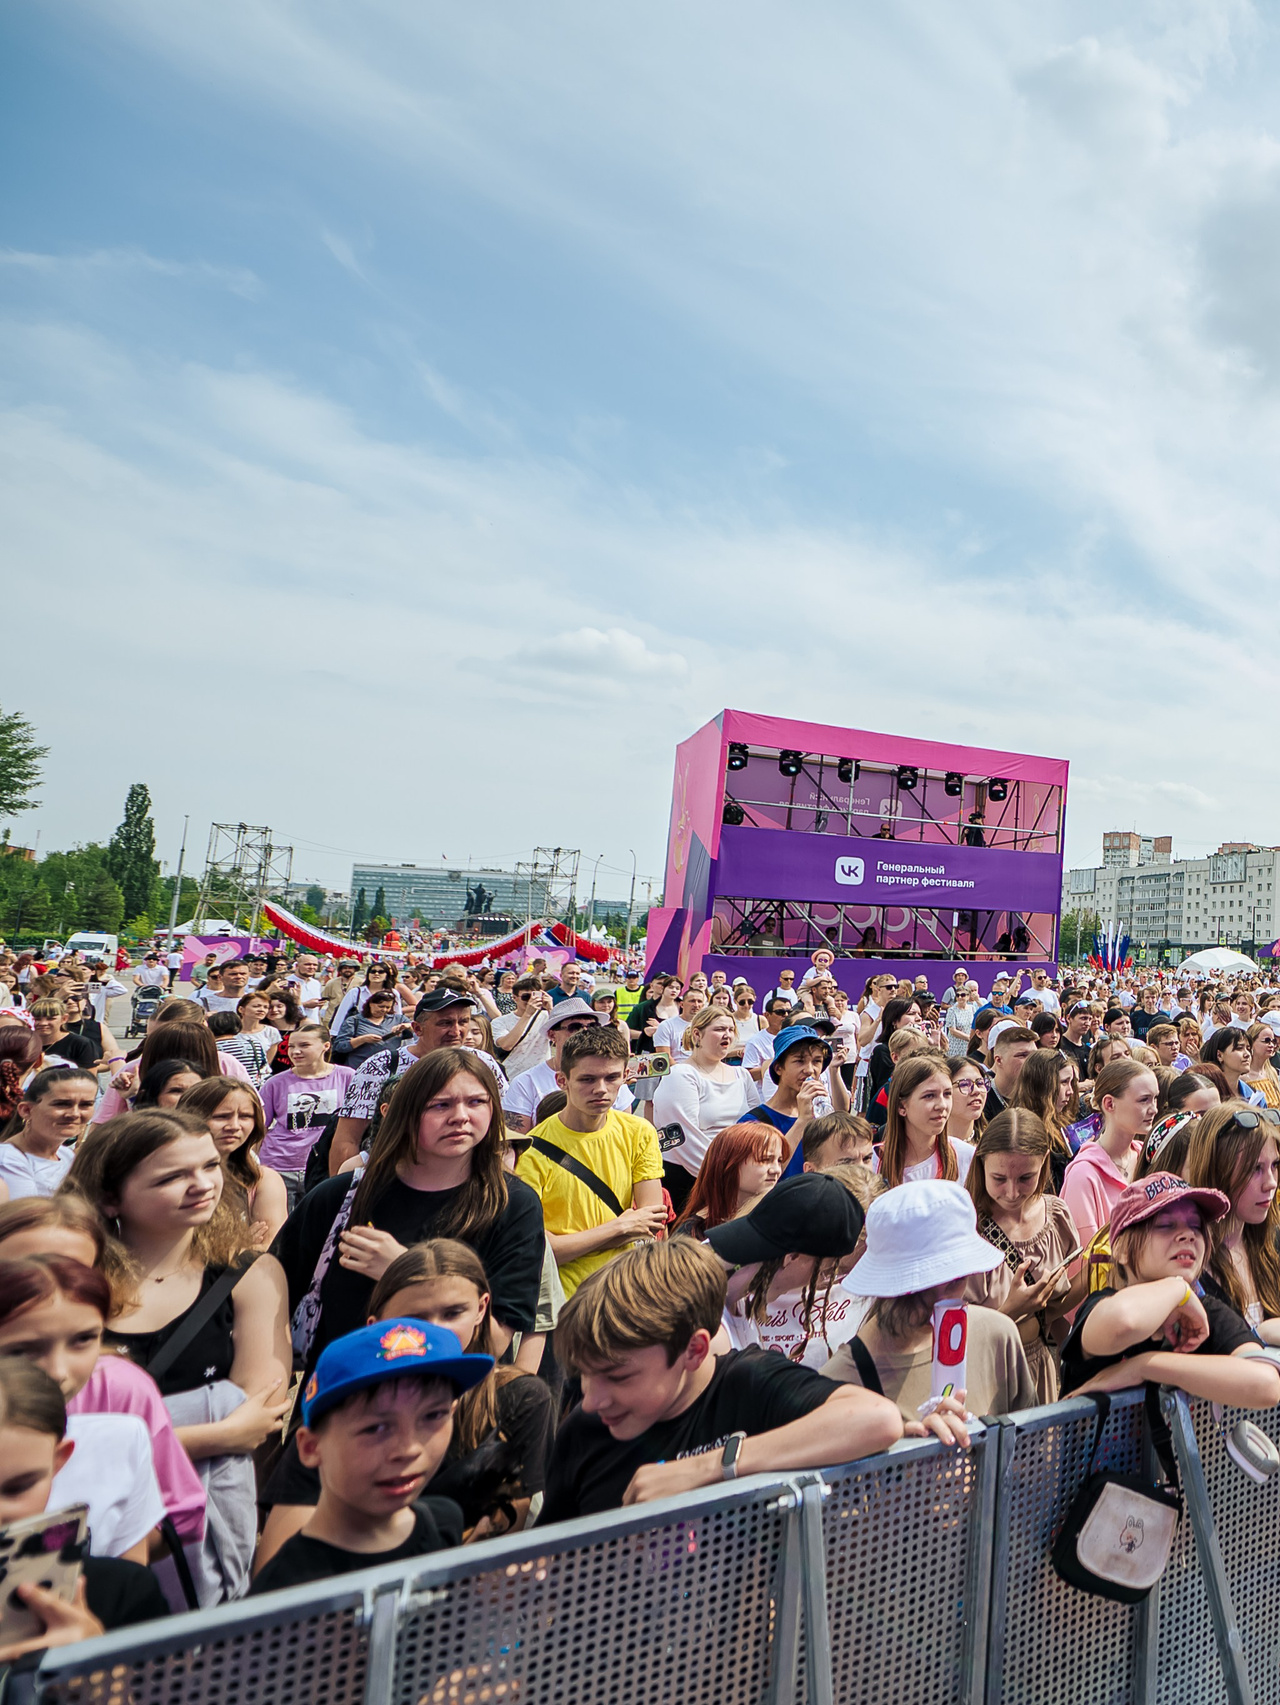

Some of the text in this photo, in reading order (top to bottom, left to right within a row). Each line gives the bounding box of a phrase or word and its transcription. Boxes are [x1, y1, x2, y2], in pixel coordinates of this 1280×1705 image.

[877, 861, 945, 874] Генеральный
[876, 875, 975, 888] партнер фестиваля
